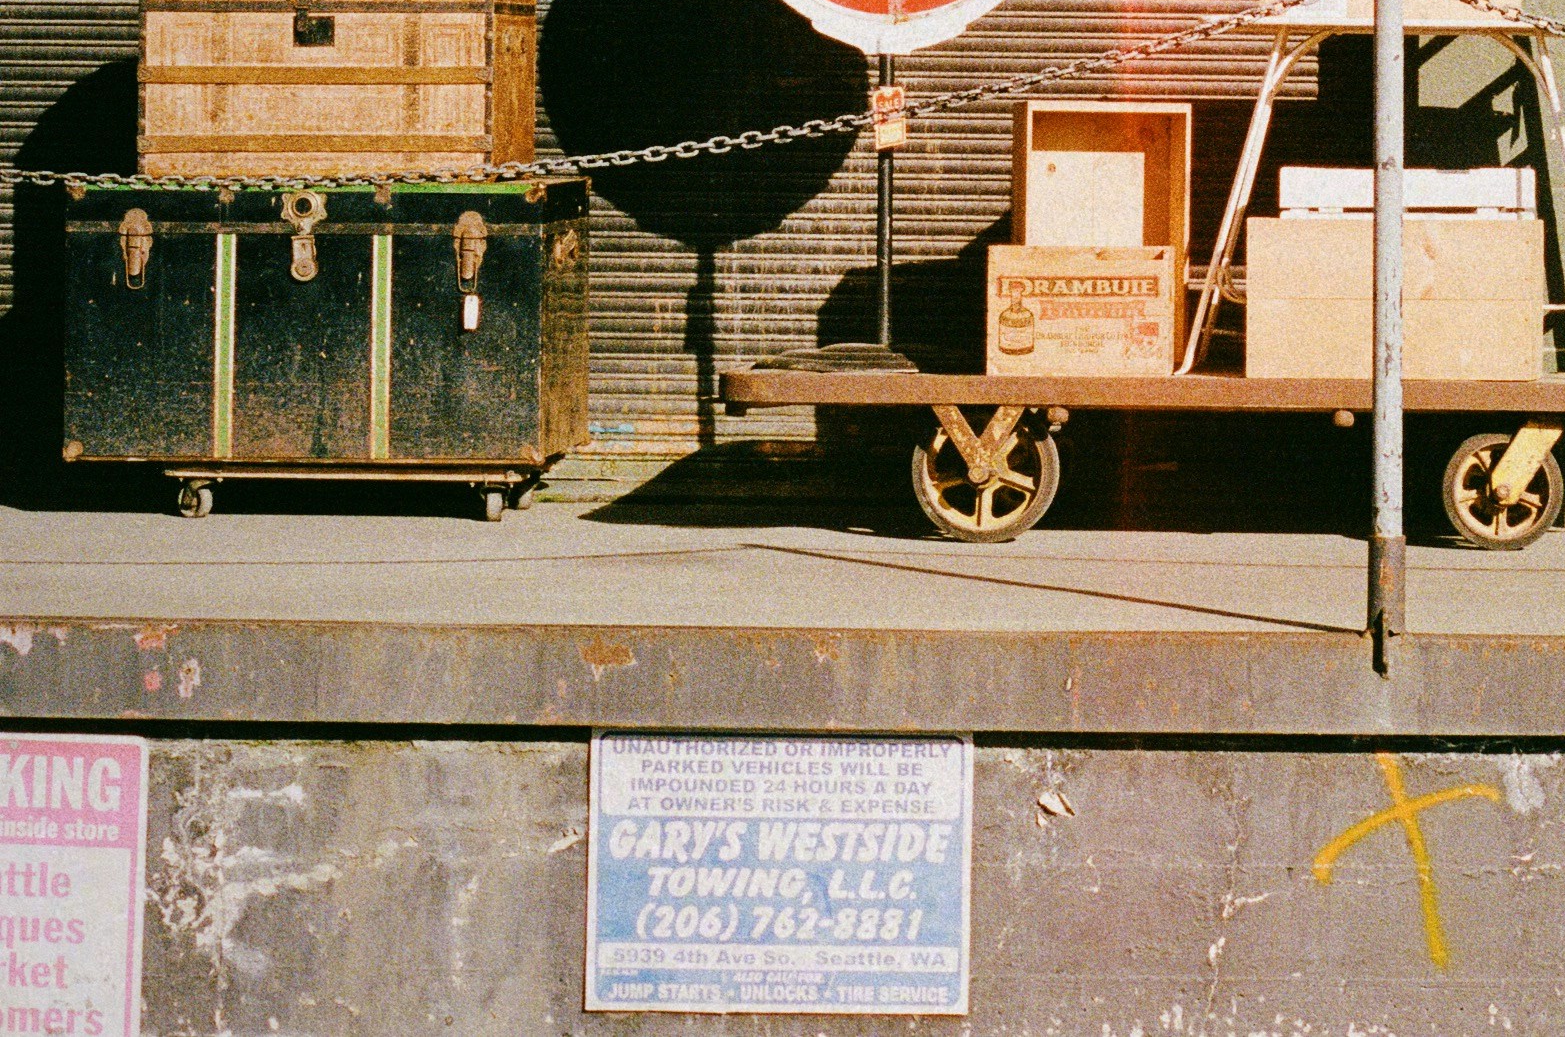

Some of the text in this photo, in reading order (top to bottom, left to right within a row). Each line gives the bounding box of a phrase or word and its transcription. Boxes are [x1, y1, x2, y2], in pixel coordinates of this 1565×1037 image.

[1001, 278, 1156, 296] DRAMBUIE
[612, 740, 950, 758] UNAUTHORIZED OR IMPROPERLY
[641, 759, 923, 776] PARKED VEHICLES WILL BE
[0, 754, 122, 812] KING
[630, 778, 932, 795] IMPOUNDED 24 HOURS A DAY
[628, 797, 935, 814] AT OWNER'S RISK & EXPENSE
[64, 818, 119, 841] store
[608, 819, 953, 864] GARY'S WESTSIDE
[0, 862, 71, 898] ttle
[648, 866, 917, 903] TOWING, L.L.C.
[635, 904, 923, 941] (206) 762-8881
[613, 948, 666, 964] 5939
[673, 949, 708, 964] 4th
[717, 949, 756, 965] Ave
[763, 950, 796, 966] So.
[911, 951, 946, 967] WA
[0, 951, 69, 990] ket
[607, 983, 949, 1003] JUMP STARTS UNLOCKS TIRE SERVICE
[0, 1007, 103, 1035] mers
